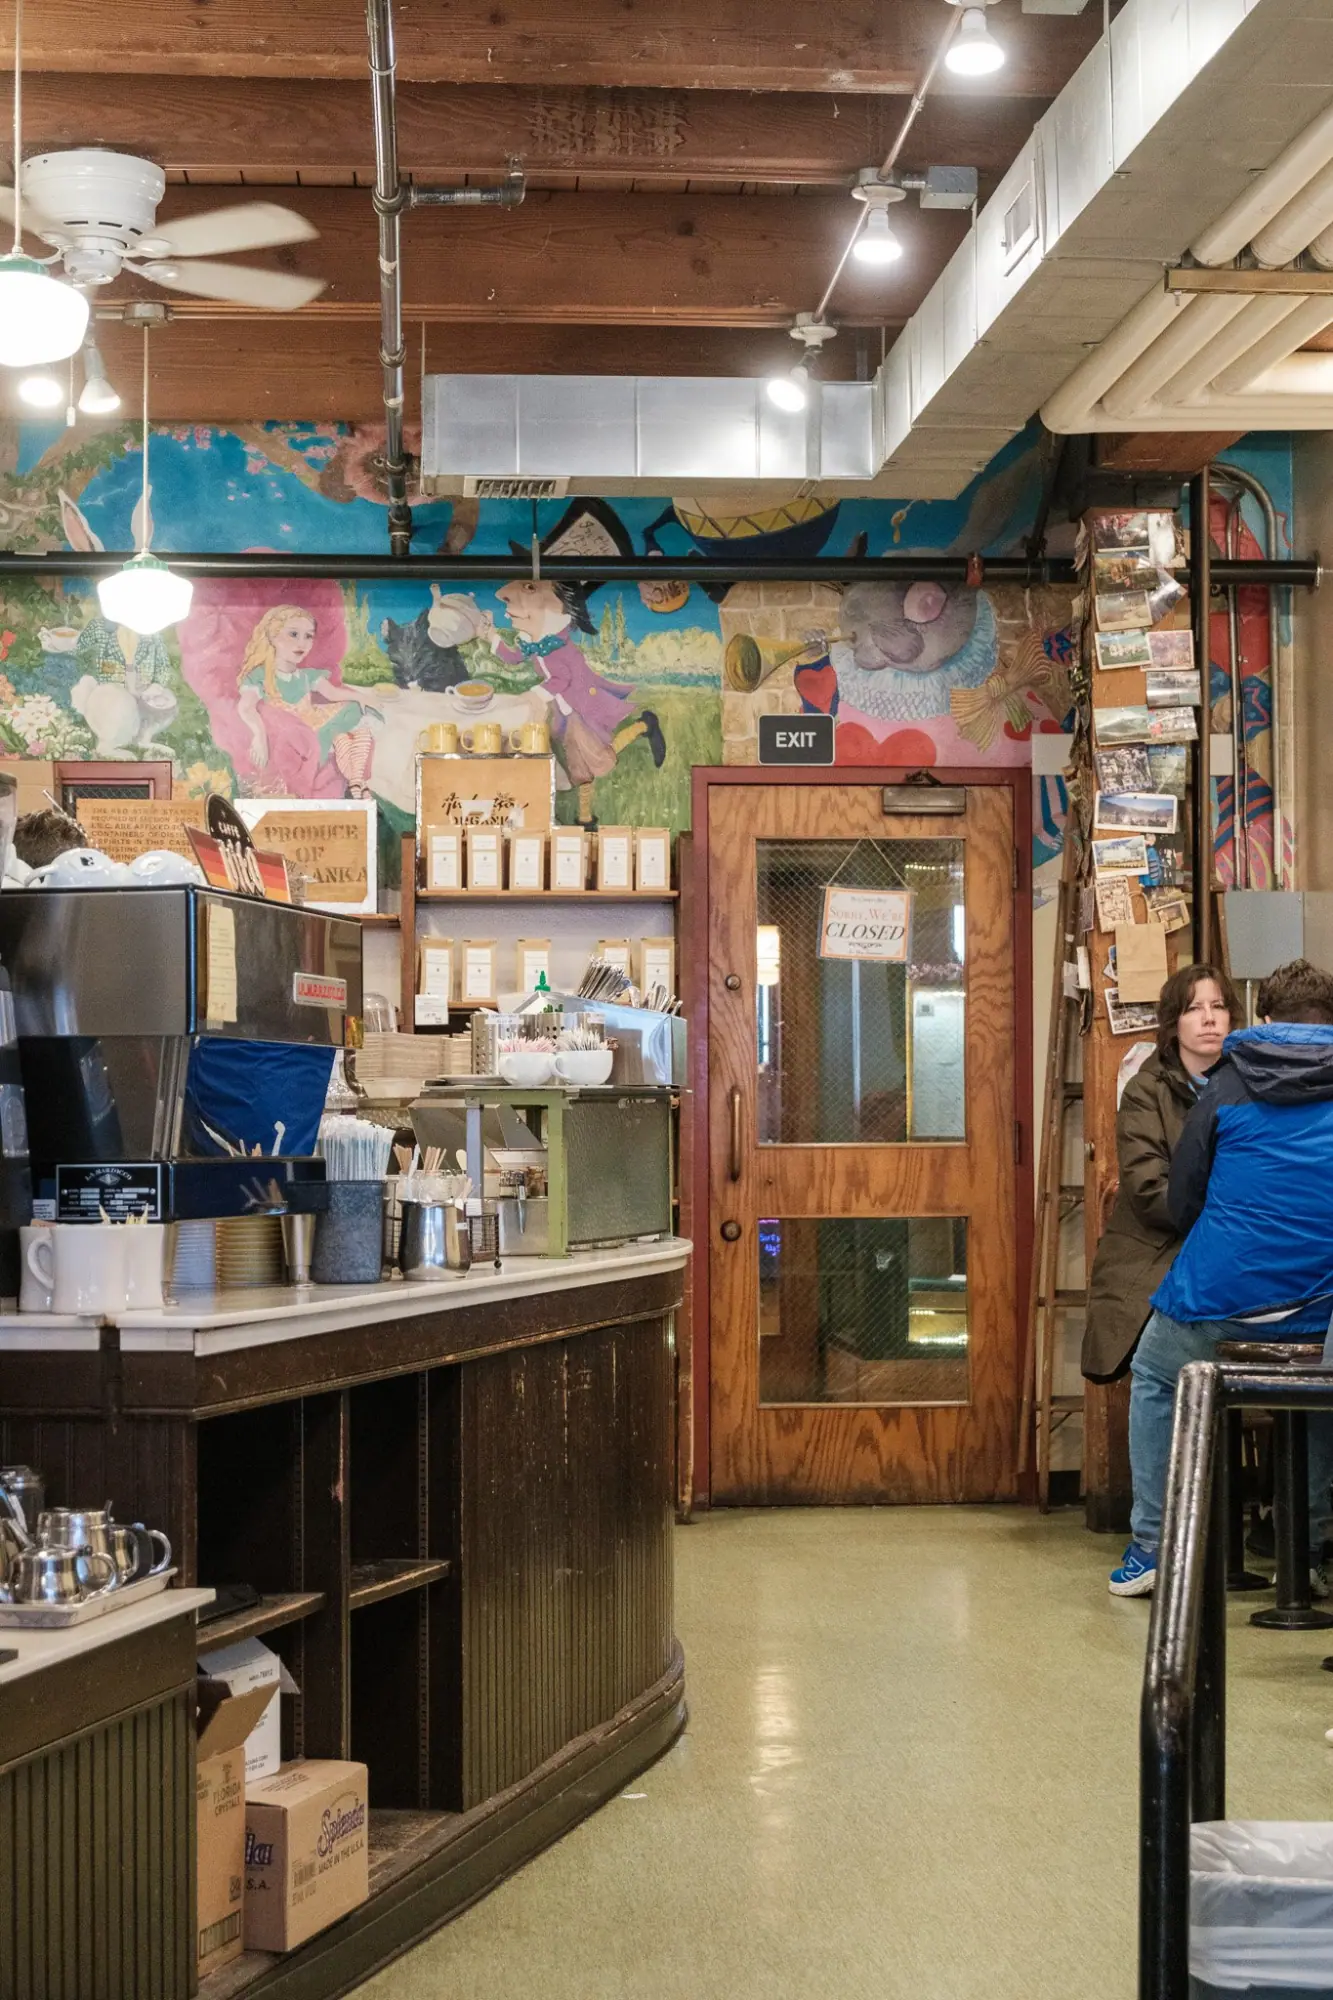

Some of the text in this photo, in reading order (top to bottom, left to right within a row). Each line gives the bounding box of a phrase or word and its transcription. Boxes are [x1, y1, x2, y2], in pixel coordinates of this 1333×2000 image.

[775, 731, 817, 748] EXIT
[91, 830, 145, 838] CONTAINERS
[264, 824, 359, 843] PRODUCE
[295, 846, 325, 863] OF
[312, 867, 368, 884] ANKA
[825, 921, 906, 941] CLOSED
[212, 1780, 241, 1802] FLORIDA
[340, 1848, 350, 1860] THE
